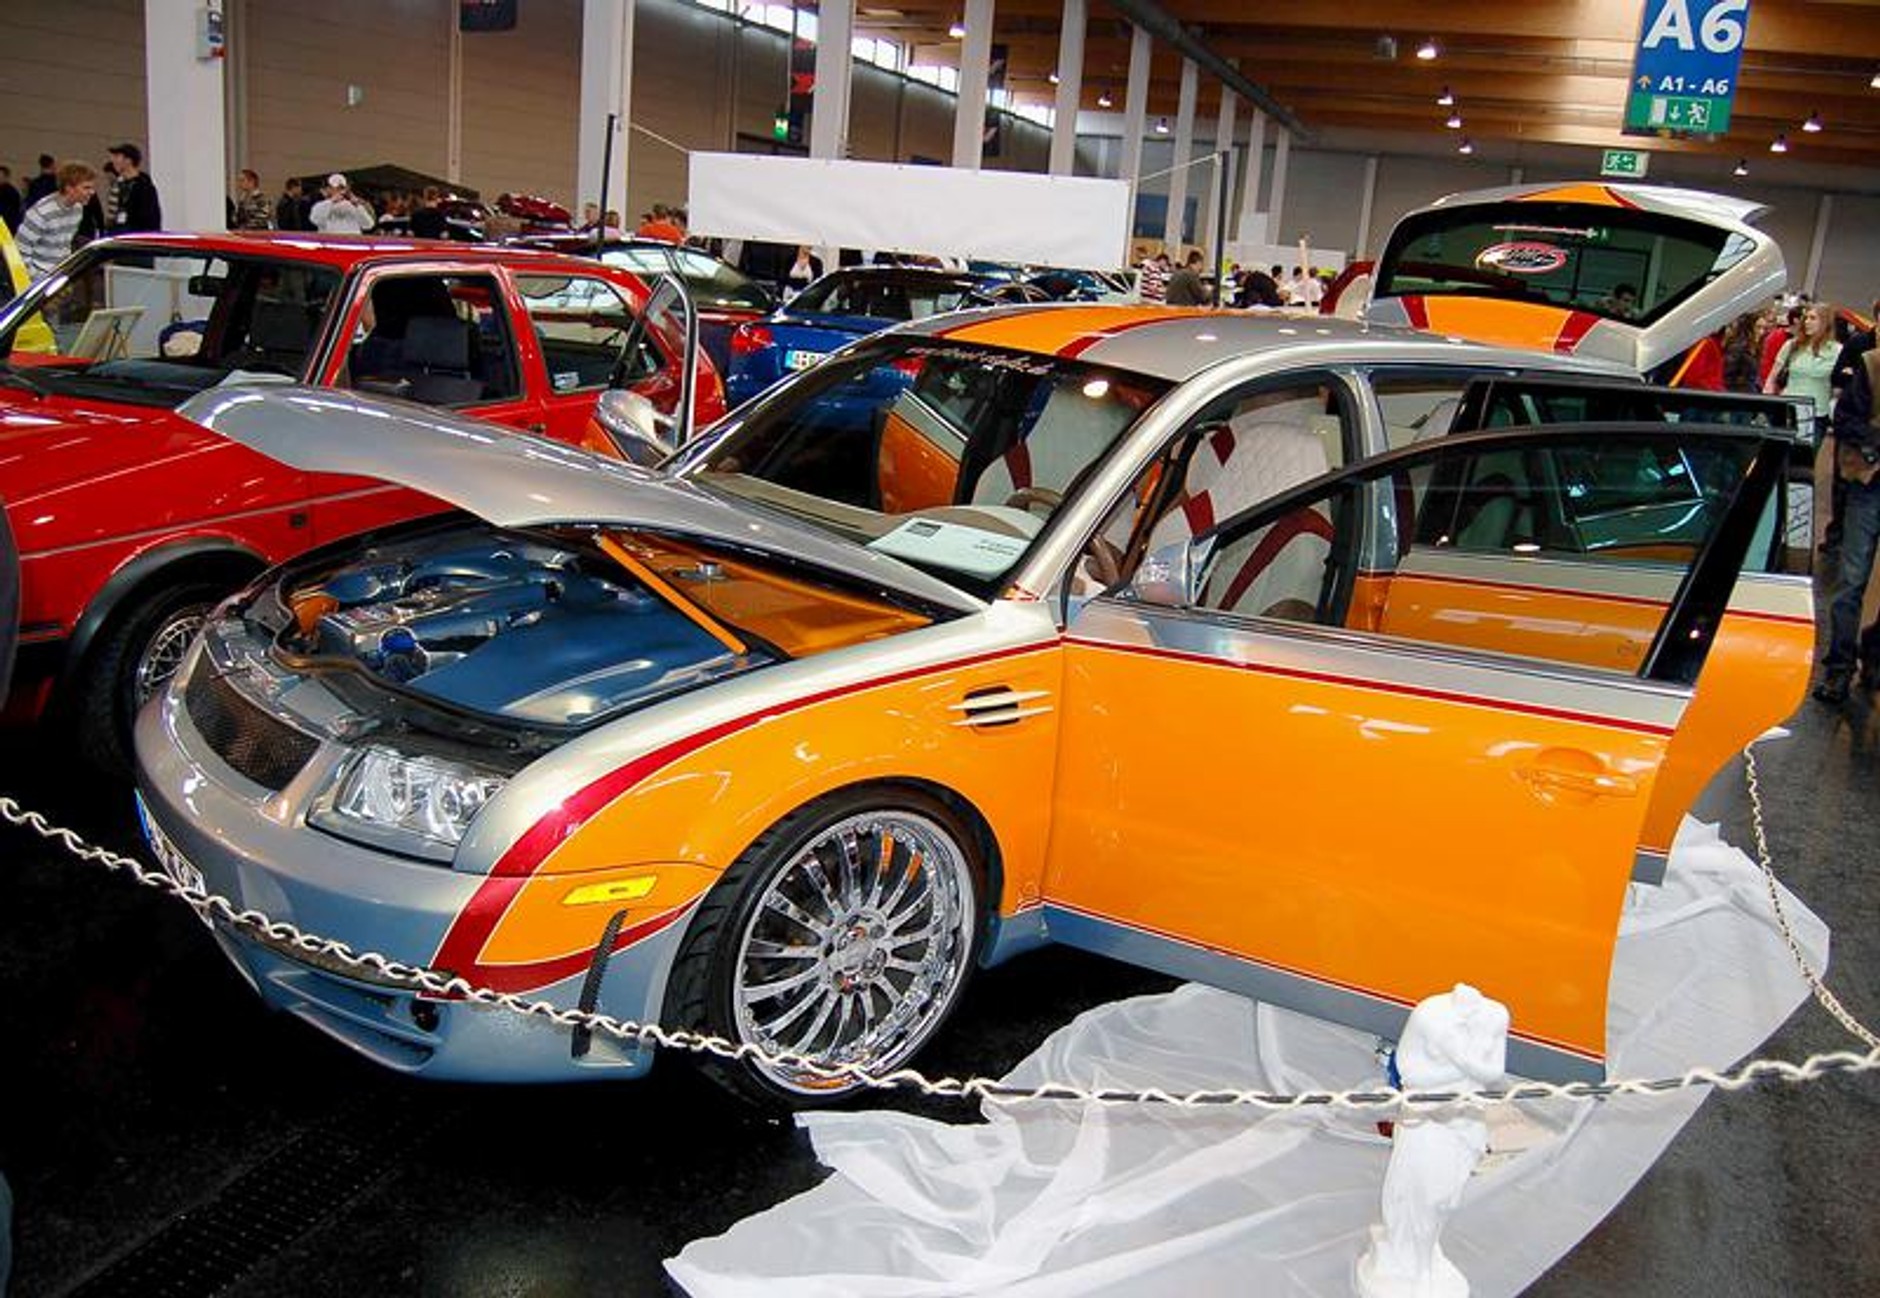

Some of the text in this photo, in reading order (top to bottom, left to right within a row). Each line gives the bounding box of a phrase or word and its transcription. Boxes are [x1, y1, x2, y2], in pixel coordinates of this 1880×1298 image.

[1642, 0, 1747, 53] A6
[1659, 75, 1685, 92] A1
[1701, 78, 1730, 95] A6
